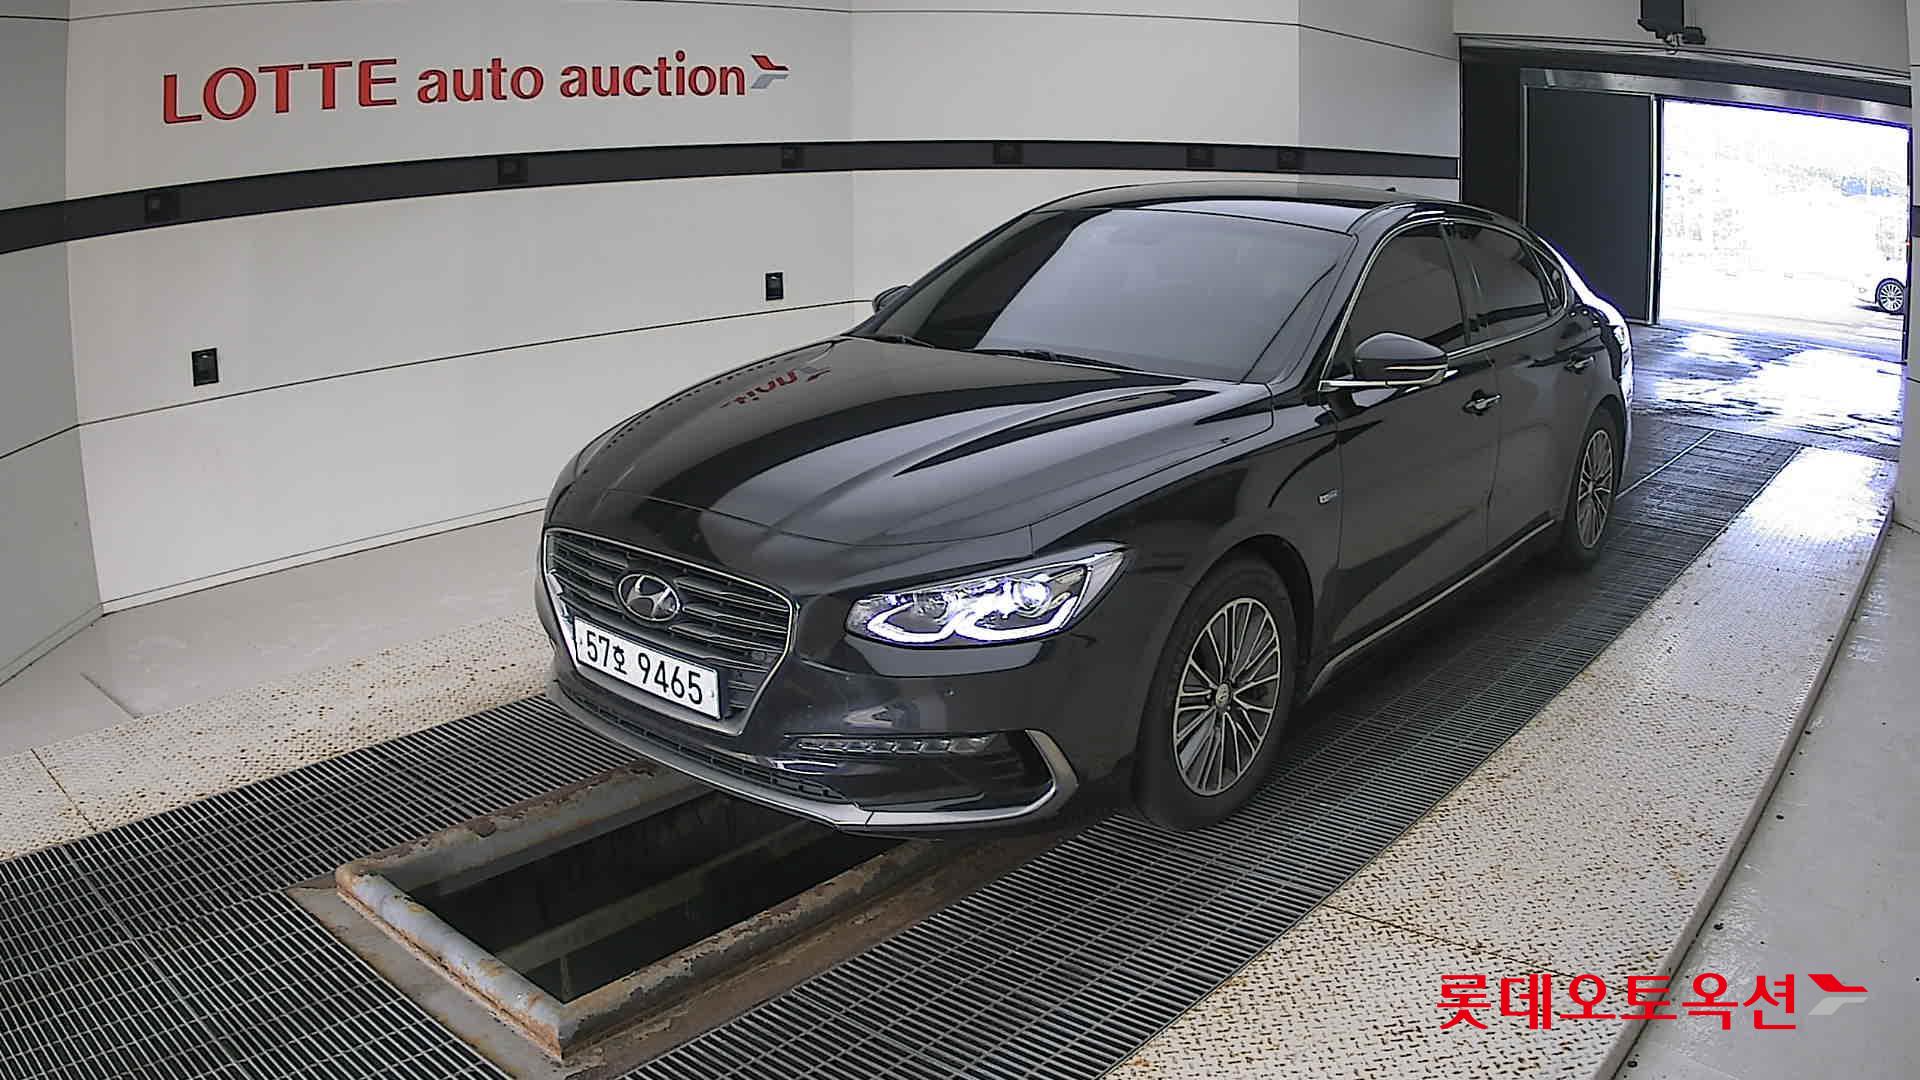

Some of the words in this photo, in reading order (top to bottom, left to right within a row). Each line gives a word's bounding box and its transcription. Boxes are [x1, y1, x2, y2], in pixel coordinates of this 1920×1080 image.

[162, 58, 398, 125] LOTTE
[416, 57, 544, 104] auto
[560, 50, 746, 98] auction
[586, 630, 627, 675] 57호
[637, 652, 703, 705] 9465
